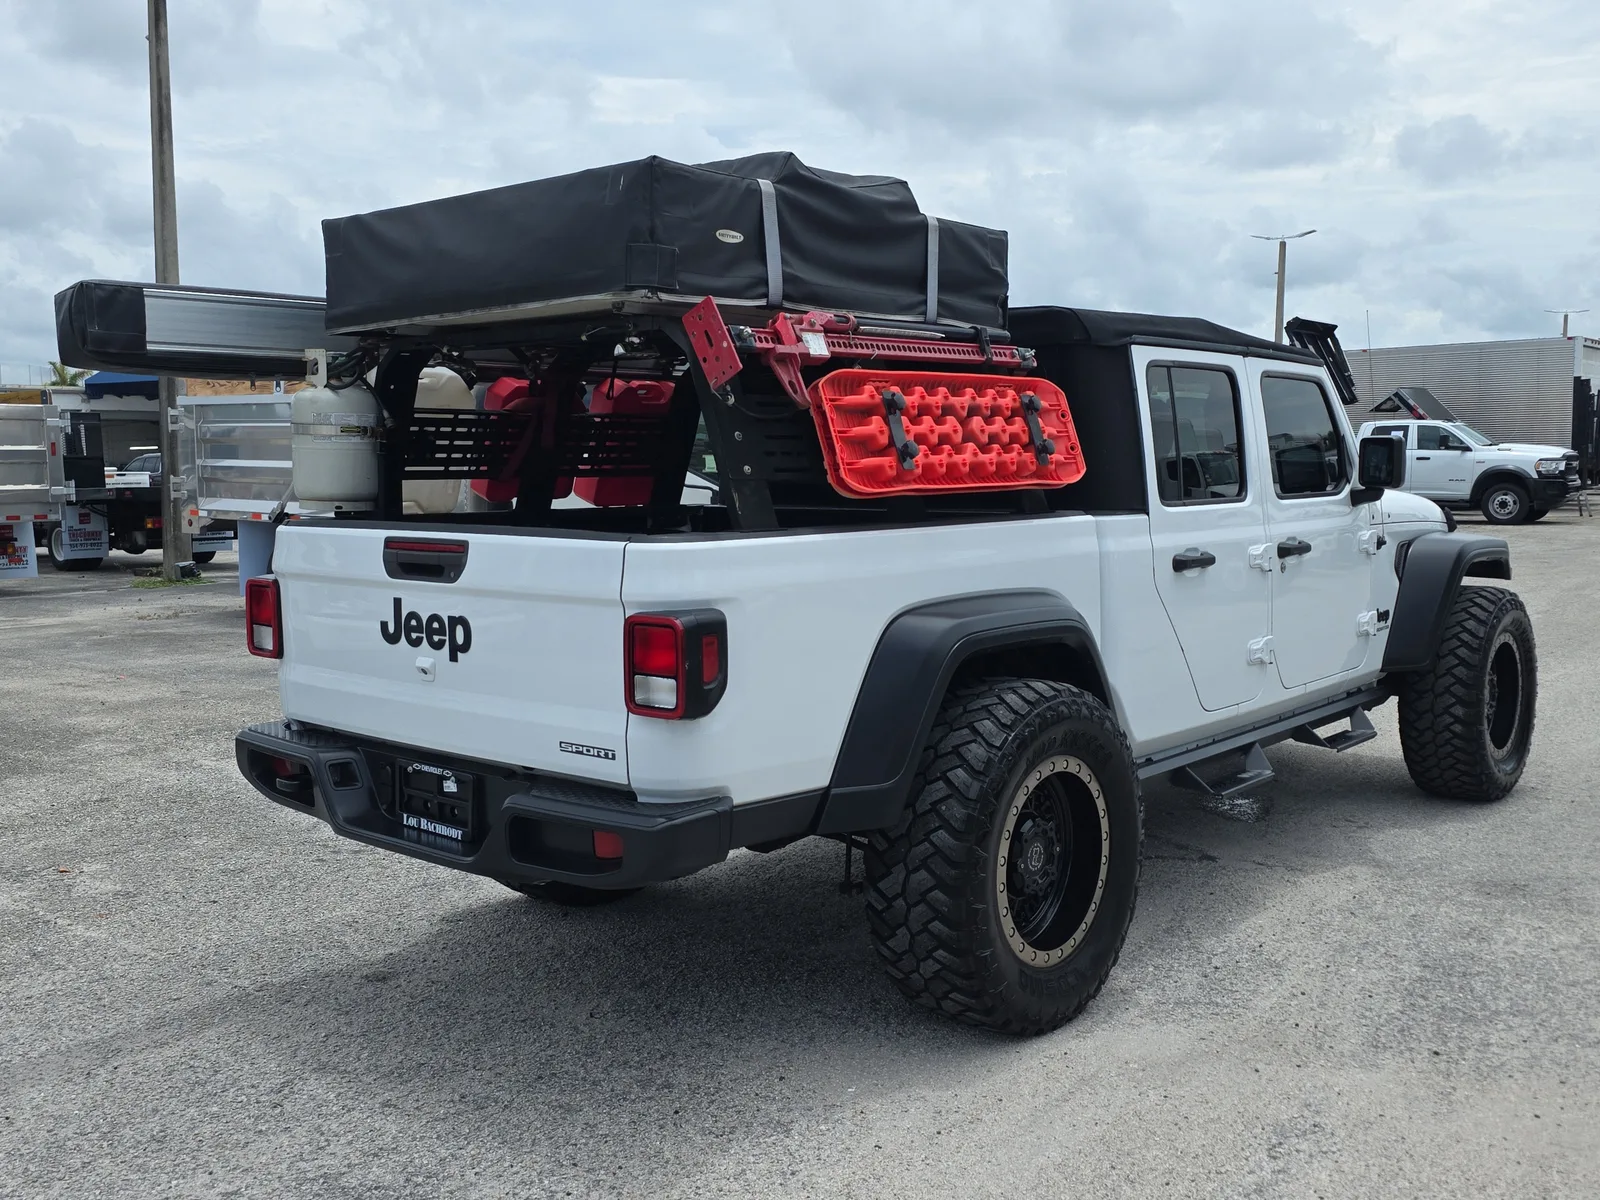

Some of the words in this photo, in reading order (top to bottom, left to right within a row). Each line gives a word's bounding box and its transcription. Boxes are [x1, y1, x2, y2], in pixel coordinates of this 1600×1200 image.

[380, 597, 472, 662] Jeep
[560, 742, 616, 760] SPORT
[421, 764, 444, 775] CHEVROLET
